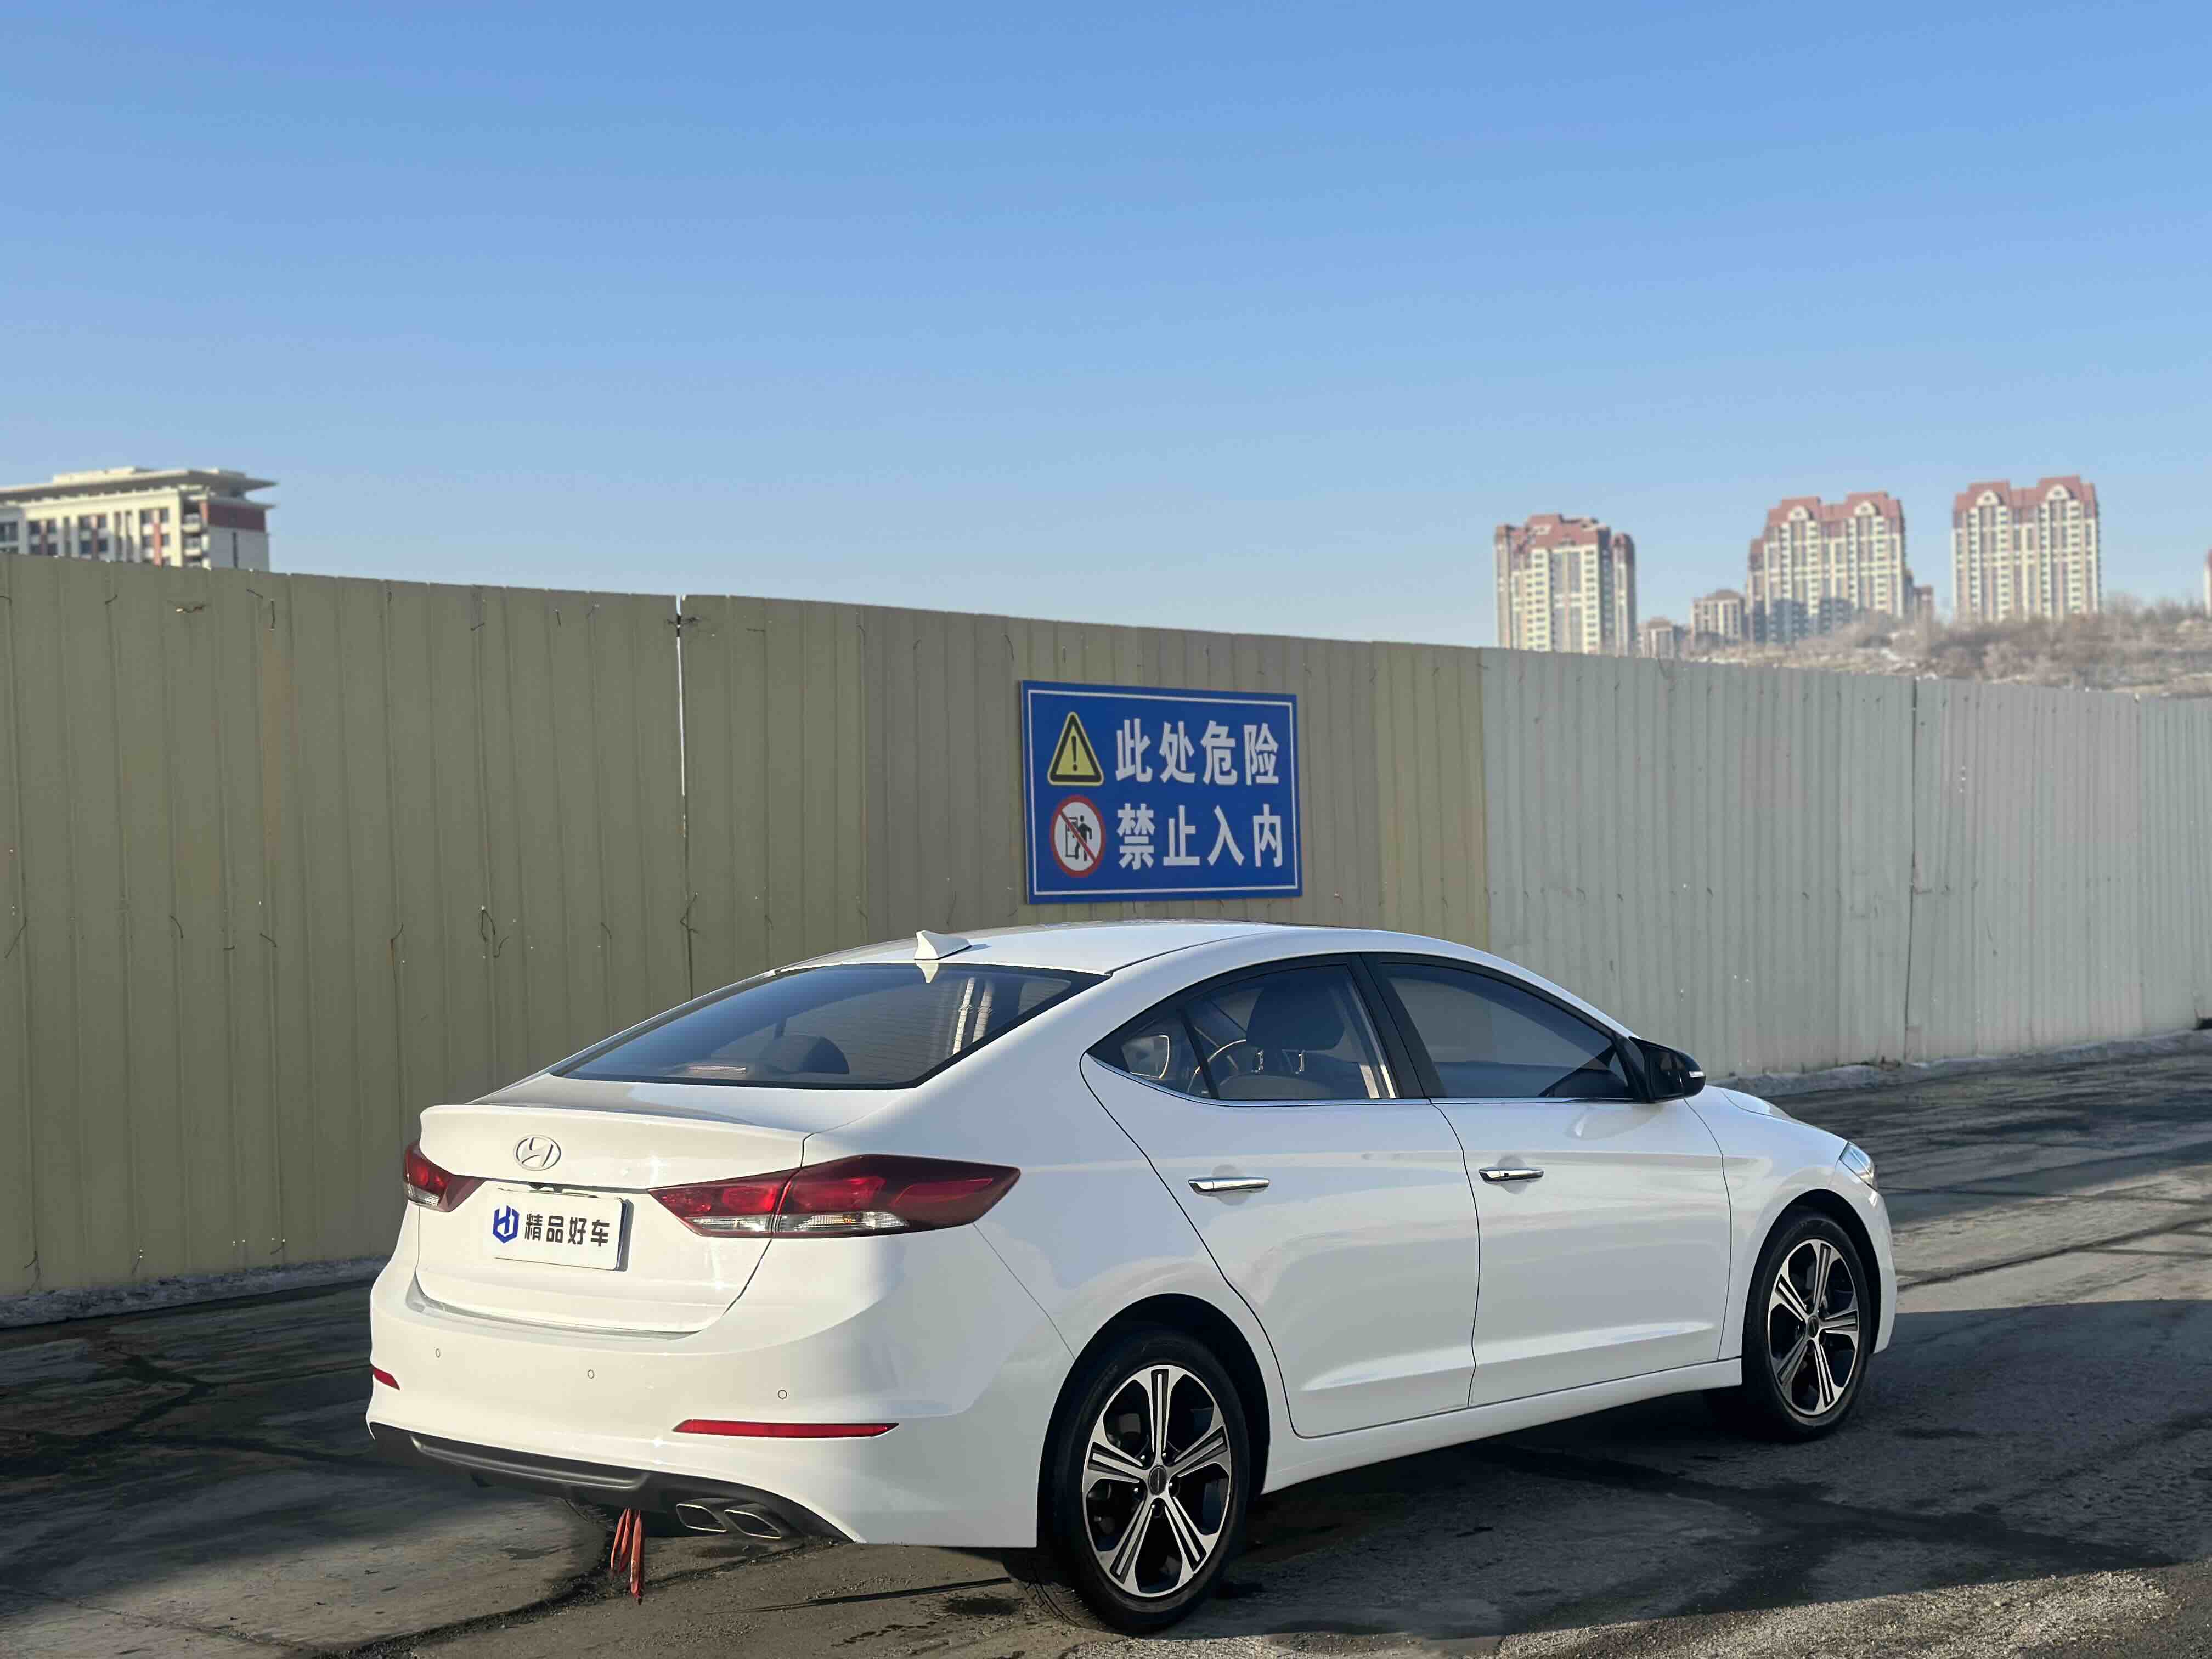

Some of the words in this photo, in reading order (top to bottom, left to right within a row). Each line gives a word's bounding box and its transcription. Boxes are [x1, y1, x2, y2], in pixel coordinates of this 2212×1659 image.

[1115, 718, 1279, 786] 此处危险
[1116, 803, 1283, 870] 禁止入内
[524, 1213, 610, 1247] 精品好车
